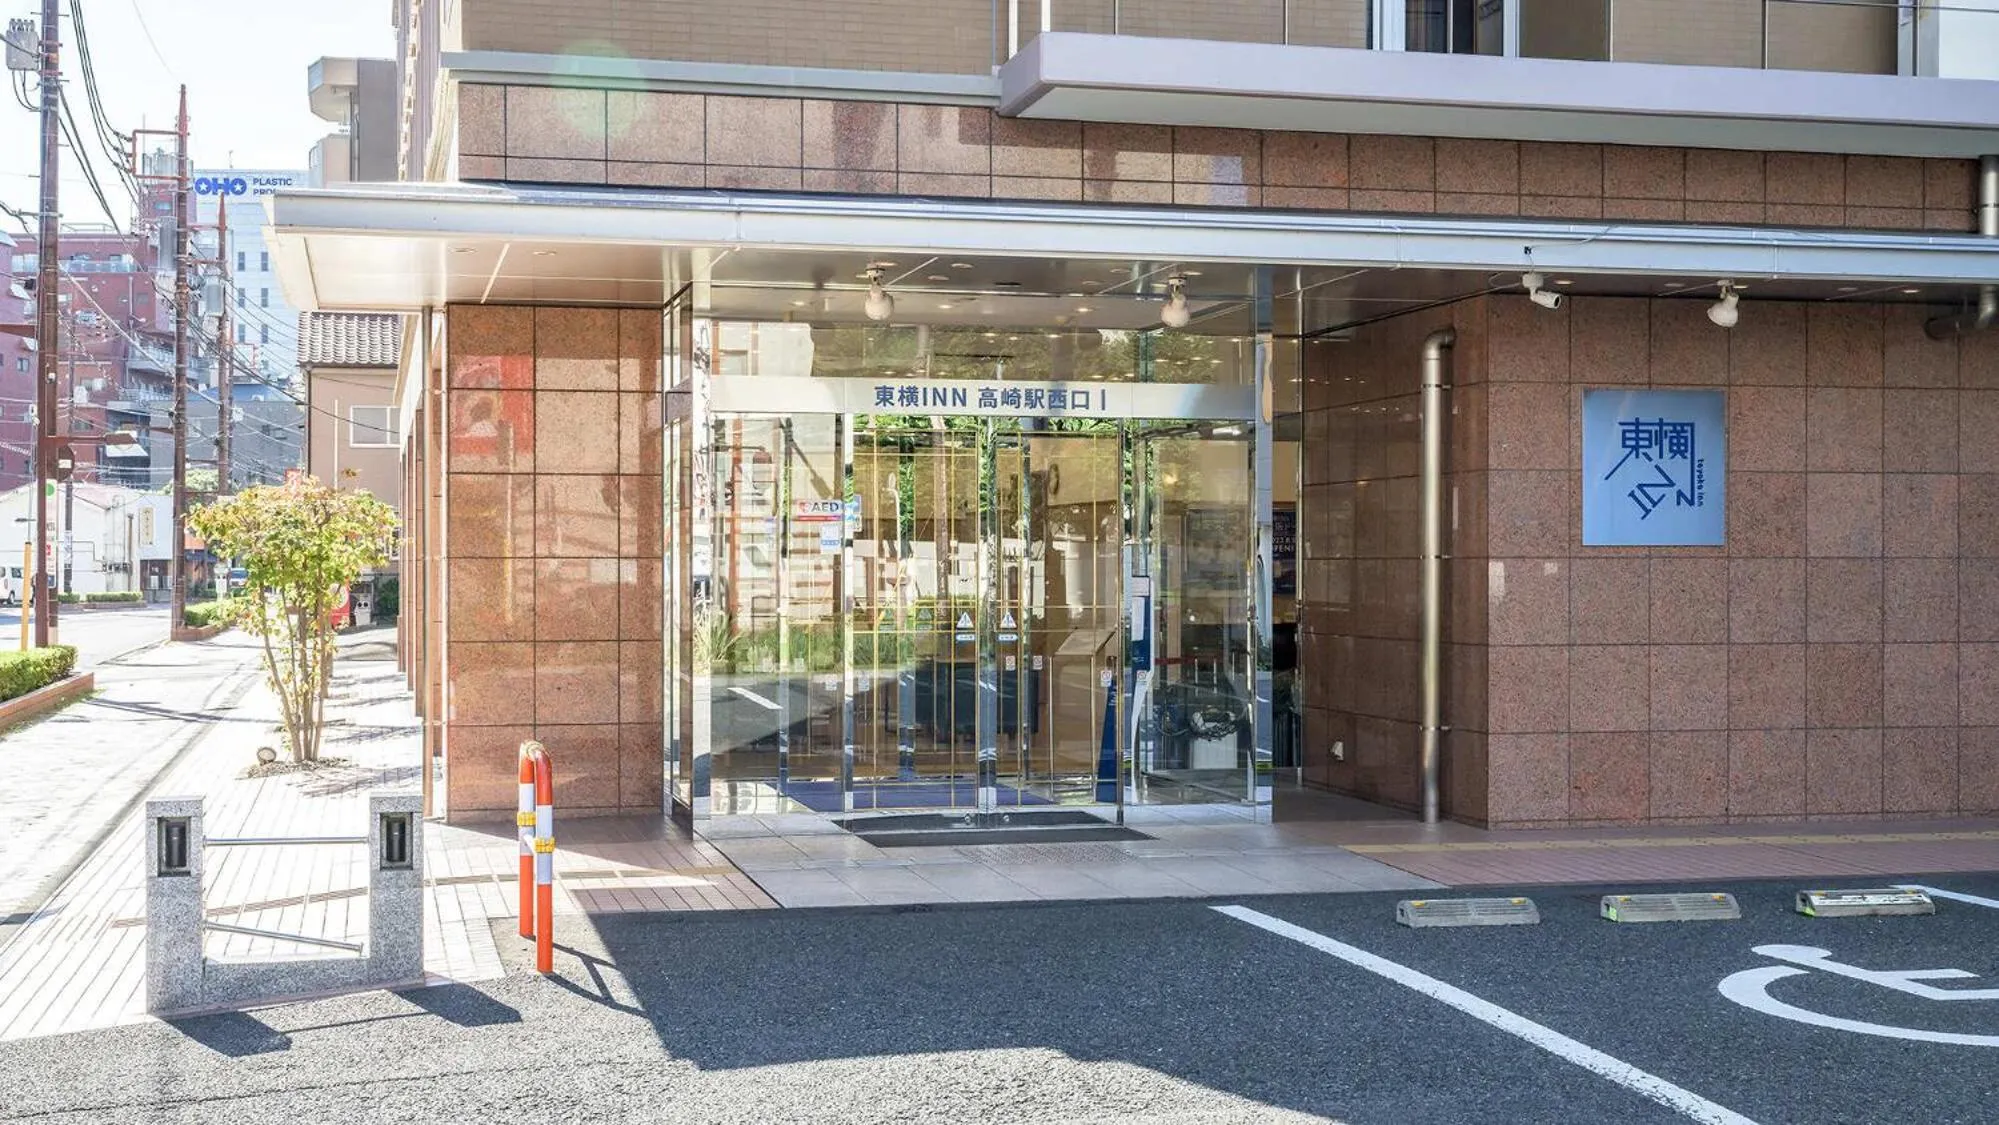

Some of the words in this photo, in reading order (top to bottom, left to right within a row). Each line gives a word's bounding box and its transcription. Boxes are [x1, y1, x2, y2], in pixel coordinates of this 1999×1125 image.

[252, 178, 293, 186] PLASTIC
[874, 385, 967, 407] 東横INN
[811, 502, 839, 512] AED
